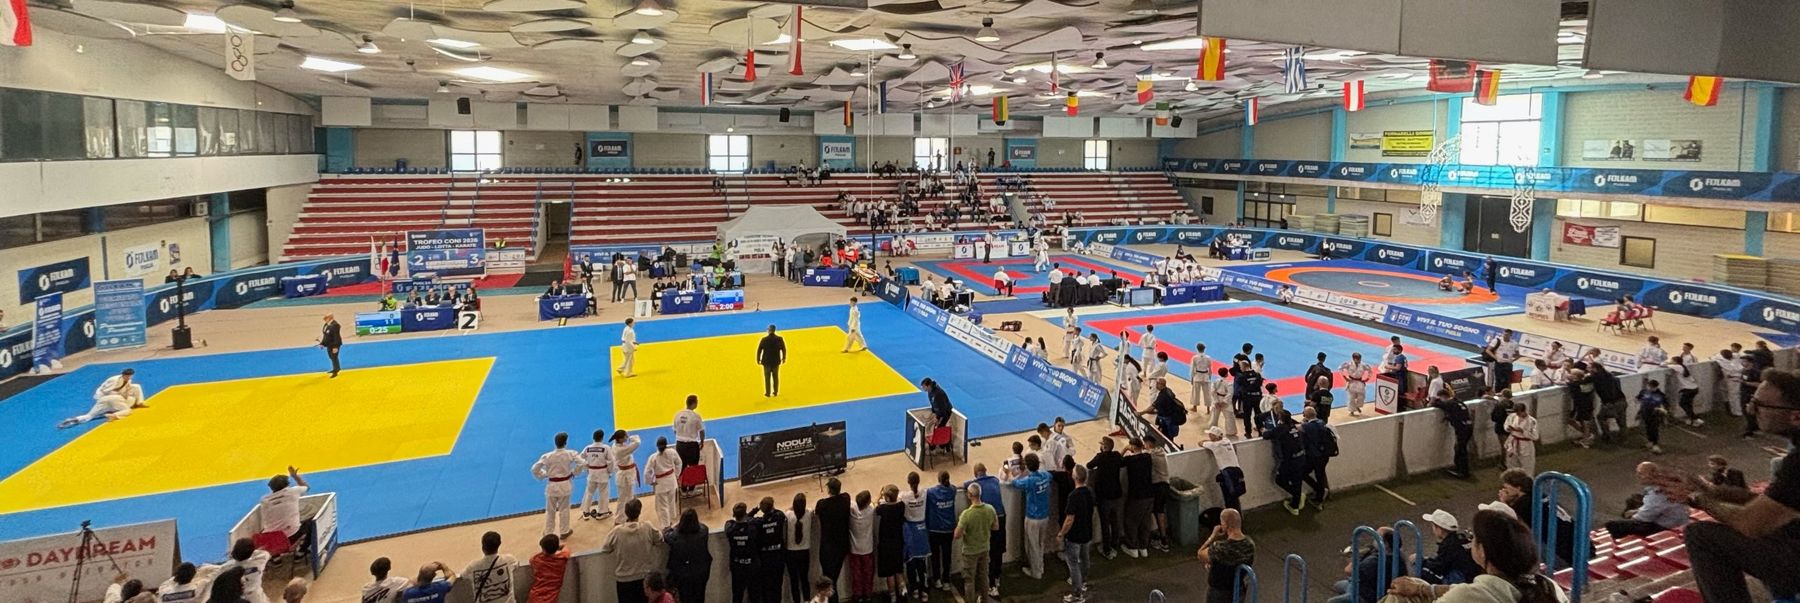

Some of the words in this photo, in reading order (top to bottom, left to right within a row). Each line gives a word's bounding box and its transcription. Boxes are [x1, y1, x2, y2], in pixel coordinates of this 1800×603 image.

[415, 255, 424, 266] 2
[469, 253, 479, 264] 3
[461, 313, 476, 329] 2
[26, 536, 156, 567] DAYDREAM
